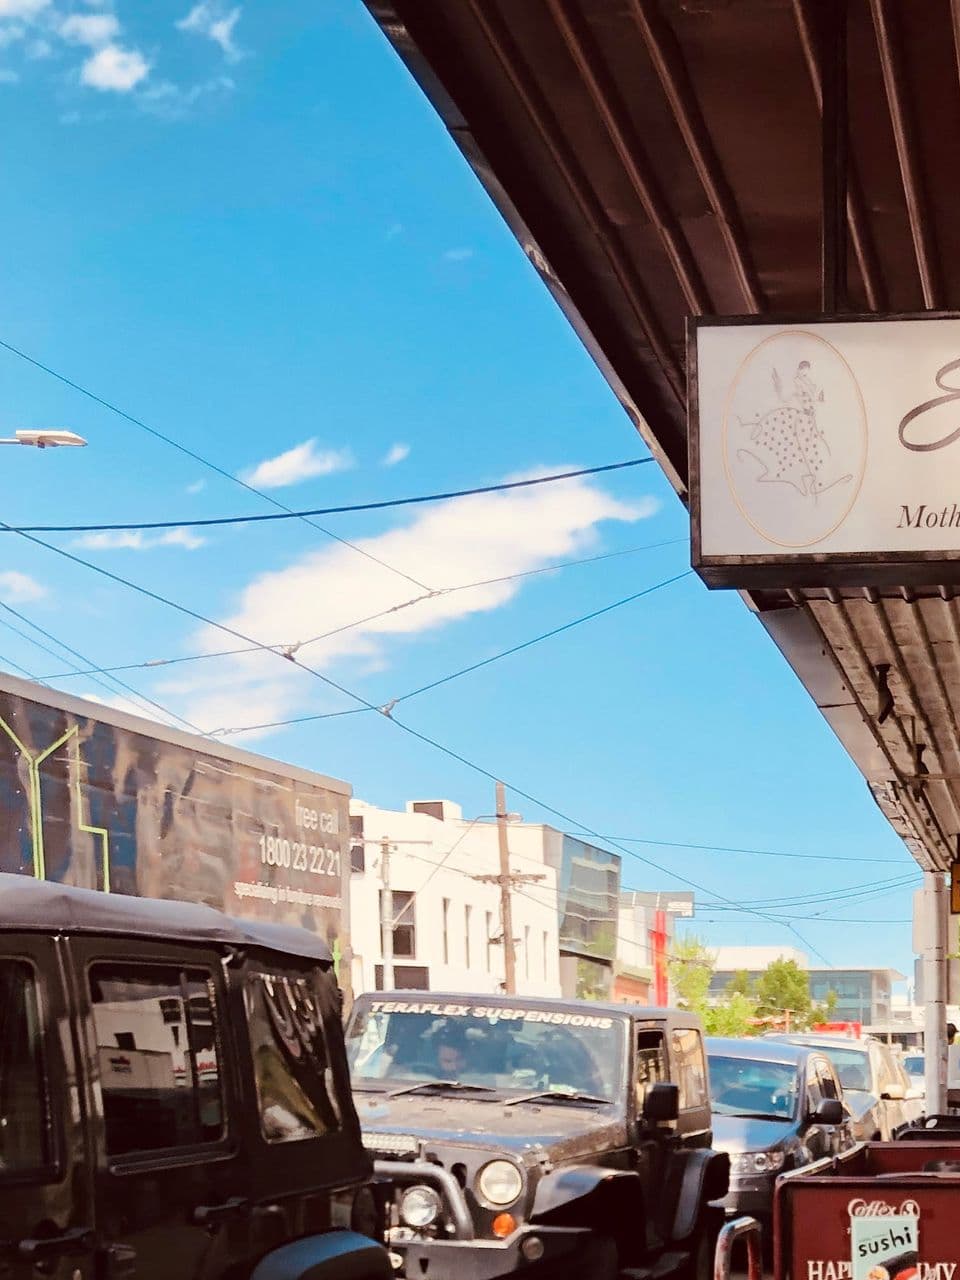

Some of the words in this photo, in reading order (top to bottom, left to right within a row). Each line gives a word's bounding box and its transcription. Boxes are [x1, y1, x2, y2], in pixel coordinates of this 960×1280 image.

[259, 835, 291, 868] 1800
[292, 842, 308, 872] 23
[309, 845, 325, 875] 22
[326, 849, 341, 877] 21
[371, 1001, 472, 1016] TERAFLEX
[472, 1006, 613, 1029] SUSPENSIONS
[858, 1226, 912, 1257] sushi
